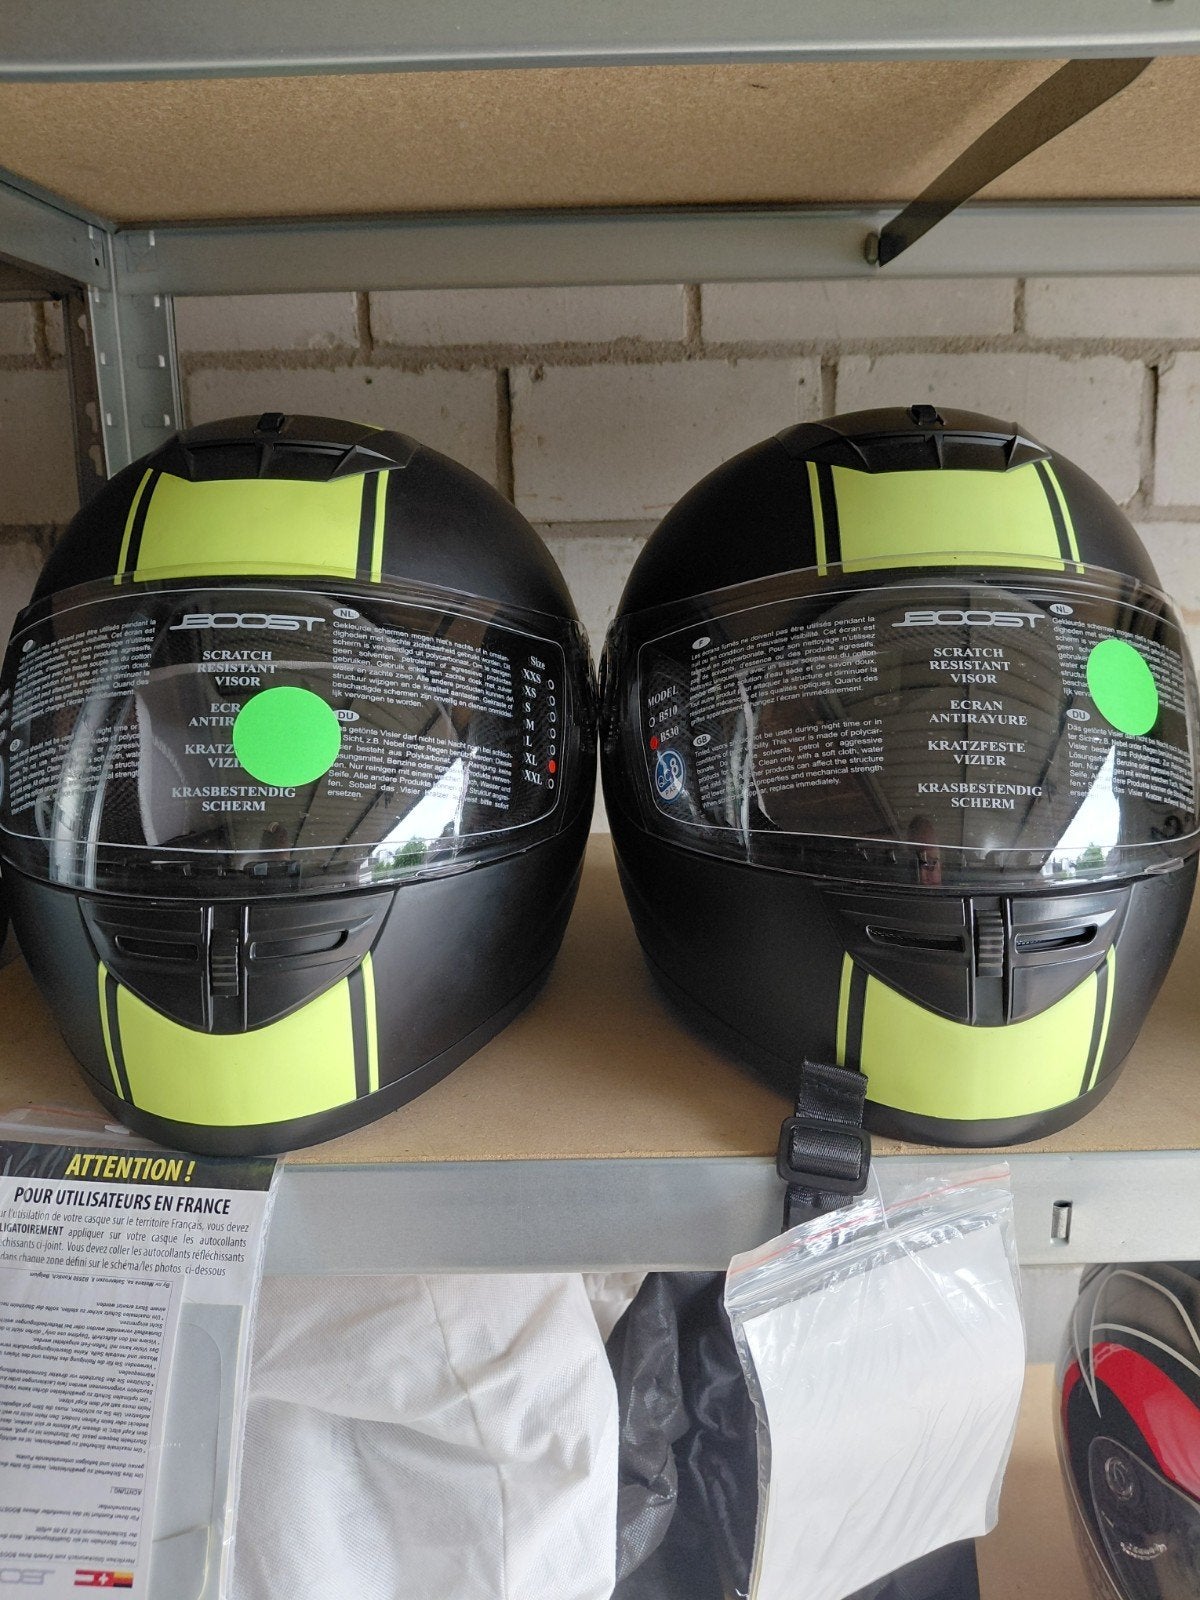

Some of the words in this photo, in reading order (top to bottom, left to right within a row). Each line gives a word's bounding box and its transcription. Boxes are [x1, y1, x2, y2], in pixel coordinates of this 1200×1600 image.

[1056, 605, 1069, 614] NL
[169, 613, 325, 631] BOOST
[834, 616, 866, 626] pendant
[891, 610, 1045, 628] BOOST
[333, 621, 372, 632] Gekleurde
[333, 630, 368, 640] digheden
[332, 639, 361, 648] scherm
[202, 650, 272, 661] SCRATCH
[332, 648, 352, 656] geen
[934, 648, 1004, 658] SCRATCH
[197, 663, 277, 674] RESISTANT
[530, 656, 546, 670] Size
[929, 660, 1010, 671] RESISTANT
[215, 676, 260, 687] VISOR
[523, 668, 541, 684] XXS
[834, 676, 862, 684] Quand
[950, 674, 998, 684] VISOR
[345, 692, 384, 702] vervangen
[525, 685, 536, 698] XS
[648, 685, 678, 708] MODEL
[210, 703, 241, 713] ECR
[525, 702, 531, 713] S
[950, 700, 1002, 710] ECRAN
[338, 712, 354, 720] DU
[659, 705, 678, 722] B510
[1072, 710, 1086, 720] DU
[188, 716, 235, 726] ANTIR
[526, 719, 535, 731] M
[929, 714, 1028, 726] ANTIRAYURE
[776, 728, 792, 737] used
[795, 725, 818, 734] during
[822, 722, 840, 730] night
[843, 720, 860, 728] time
[1067, 723, 1082, 732] Das
[380, 730, 402, 738] Visier
[660, 726, 680, 743] B530
[772, 738, 786, 746] This
[816, 731, 838, 740] made
[850, 728, 882, 738] polycar-
[526, 736, 532, 747] L
[798, 742, 820, 752] petrol
[840, 737, 883, 747] aggressive
[928, 740, 1026, 752] KRATZFESTE
[185, 744, 235, 754] KRATZ
[526, 752, 538, 766] XL
[759, 758, 778, 766] Clean
[780, 755, 795, 764] only
[797, 752, 812, 760] with
[822, 749, 836, 758] soft
[861, 746, 884, 754] water
[953, 754, 1006, 766] VIZIER
[208, 758, 243, 768] VIZI
[349, 762, 364, 770] Nur
[796, 762, 810, 770] can
[812, 759, 832, 768] affect
[850, 756, 884, 764] structure
[353, 772, 369, 780] Alle
[524, 769, 542, 785] XXL
[791, 772, 804, 780] and
[806, 766, 848, 776] mechanical
[349, 781, 376, 790] Sobald
[796, 777, 841, 788] immediately.
[172, 787, 296, 798] KRASBESTENDIG
[918, 783, 1042, 796] KRASBESTENDIG
[202, 801, 265, 811] SCHERM
[951, 798, 1015, 810] SCHERM
[65, 1154, 183, 1182] ATTENTION
[184, 1160, 196, 1182] !
[14, 1187, 53, 1204] POUR
[56, 1189, 152, 1210] UTILISATEURS
[154, 1195, 174, 1212] EN
[176, 1196, 232, 1214] FRANCE
[52, 1211, 61, 1221] de
[64, 1214, 82, 1222] votre
[84, 1216, 110, 1226] casque
[112, 1218, 125, 1226] sur
[126, 1217, 133, 1226] le
[136, 1217, 168, 1228] territoire
[171, 1219, 204, 1231] Français,
[207, 1223, 224, 1232] vous
[226, 1222, 250, 1233] devez
[0, 1222, 64, 1236] LIGATOIREMENT
[68, 1229, 104, 1240] appliquer
[110, 1232, 122, 1240] sur
[126, 1232, 146, 1241] votre
[152, 1234, 178, 1245] casque
[183, 1234, 194, 1244] les
[200, 1236, 246, 1248] autocollants
[67, 1241, 84, 1252] Vous
[86, 1242, 107, 1254] devez
[109, 1245, 128, 1255] coller
[132, 1246, 142, 1256] les
[143, 1248, 190, 1259] autocollants
[1, 1251, 17, 1260] dans
[46, 1256, 64, 1266] zone
[88, 1259, 100, 1268] sur
[102, 1258, 108, 1268] le
[154, 1262, 181, 1274] photos
[185, 1266, 226, 1276] ci-dessous
